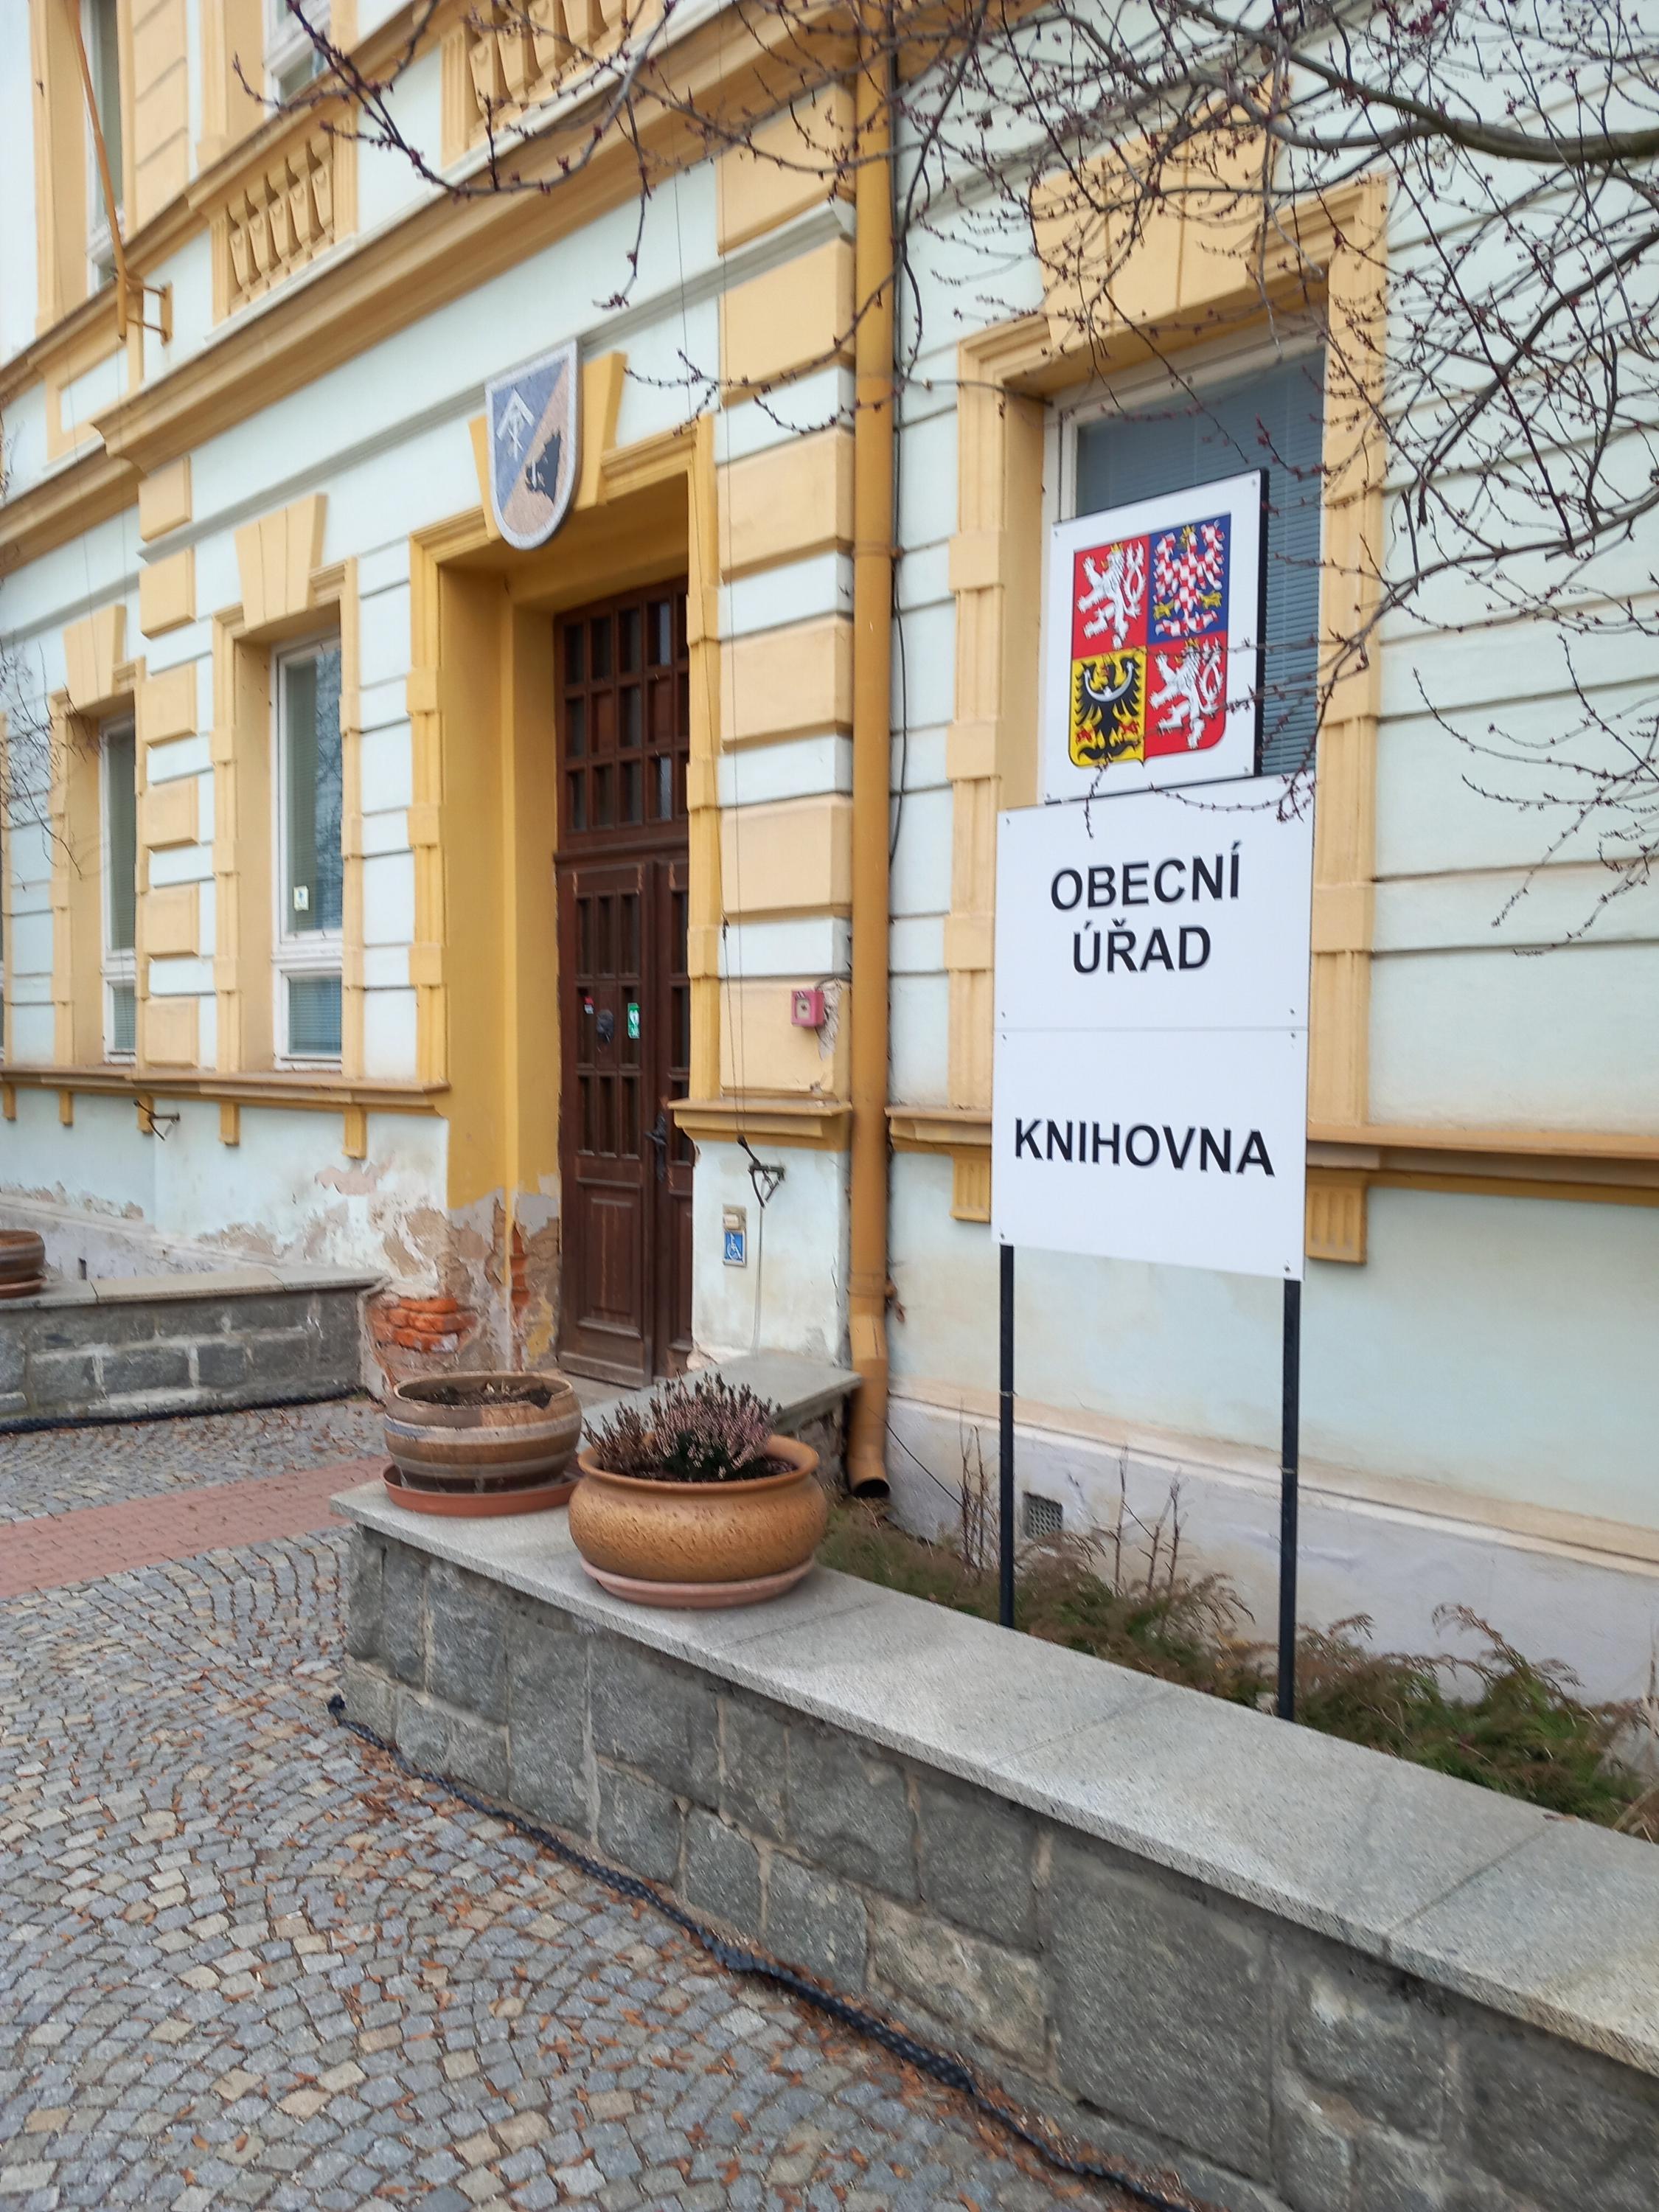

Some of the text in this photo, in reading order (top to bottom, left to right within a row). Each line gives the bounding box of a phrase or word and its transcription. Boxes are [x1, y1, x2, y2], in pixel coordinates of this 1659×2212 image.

[1051, 840, 1242, 911] OBECNÍ
[1073, 918, 1211, 974] ÚŘAD
[1015, 1118, 1276, 1178] KNIHOVNA
